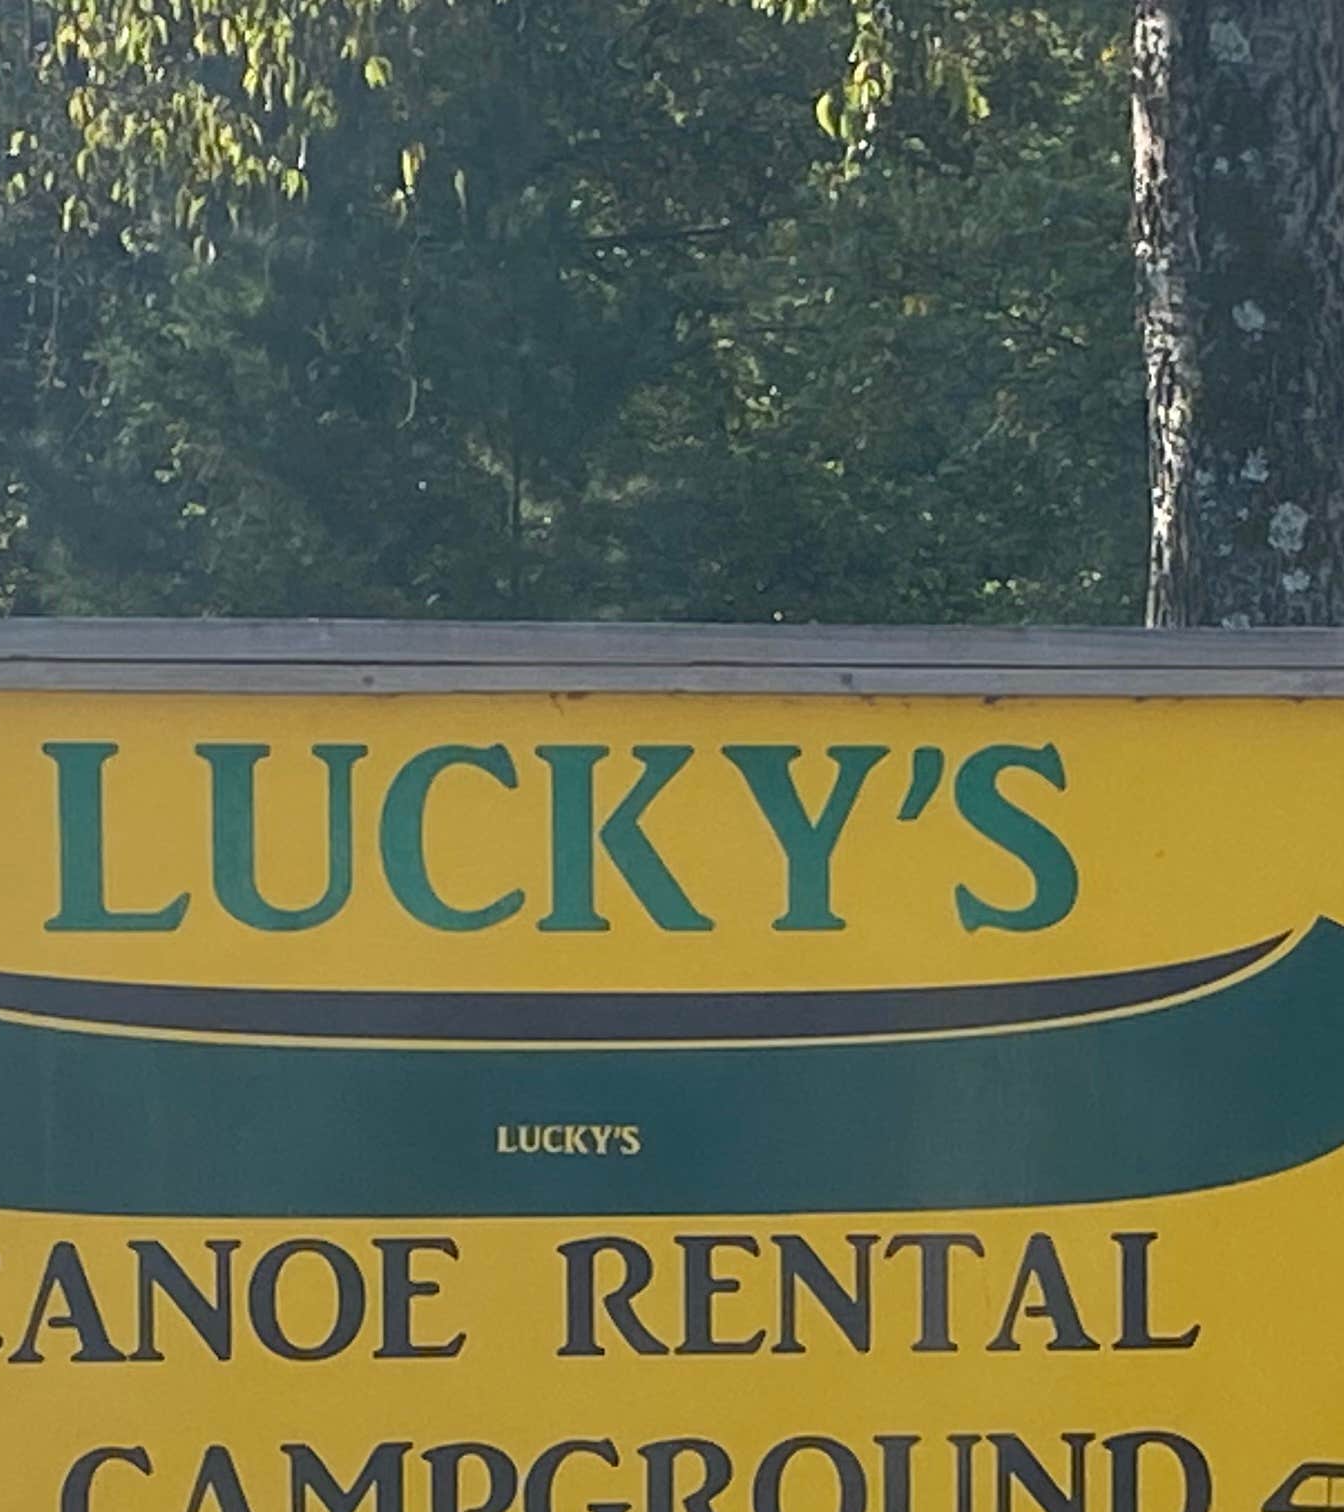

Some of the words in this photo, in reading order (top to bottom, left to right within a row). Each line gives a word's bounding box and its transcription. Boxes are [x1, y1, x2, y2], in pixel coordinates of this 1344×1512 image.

[42, 742, 1078, 932] LUCKY'S
[498, 1126, 640, 1154] LUCKY'S
[557, 1232, 1201, 1356] RENTAL
